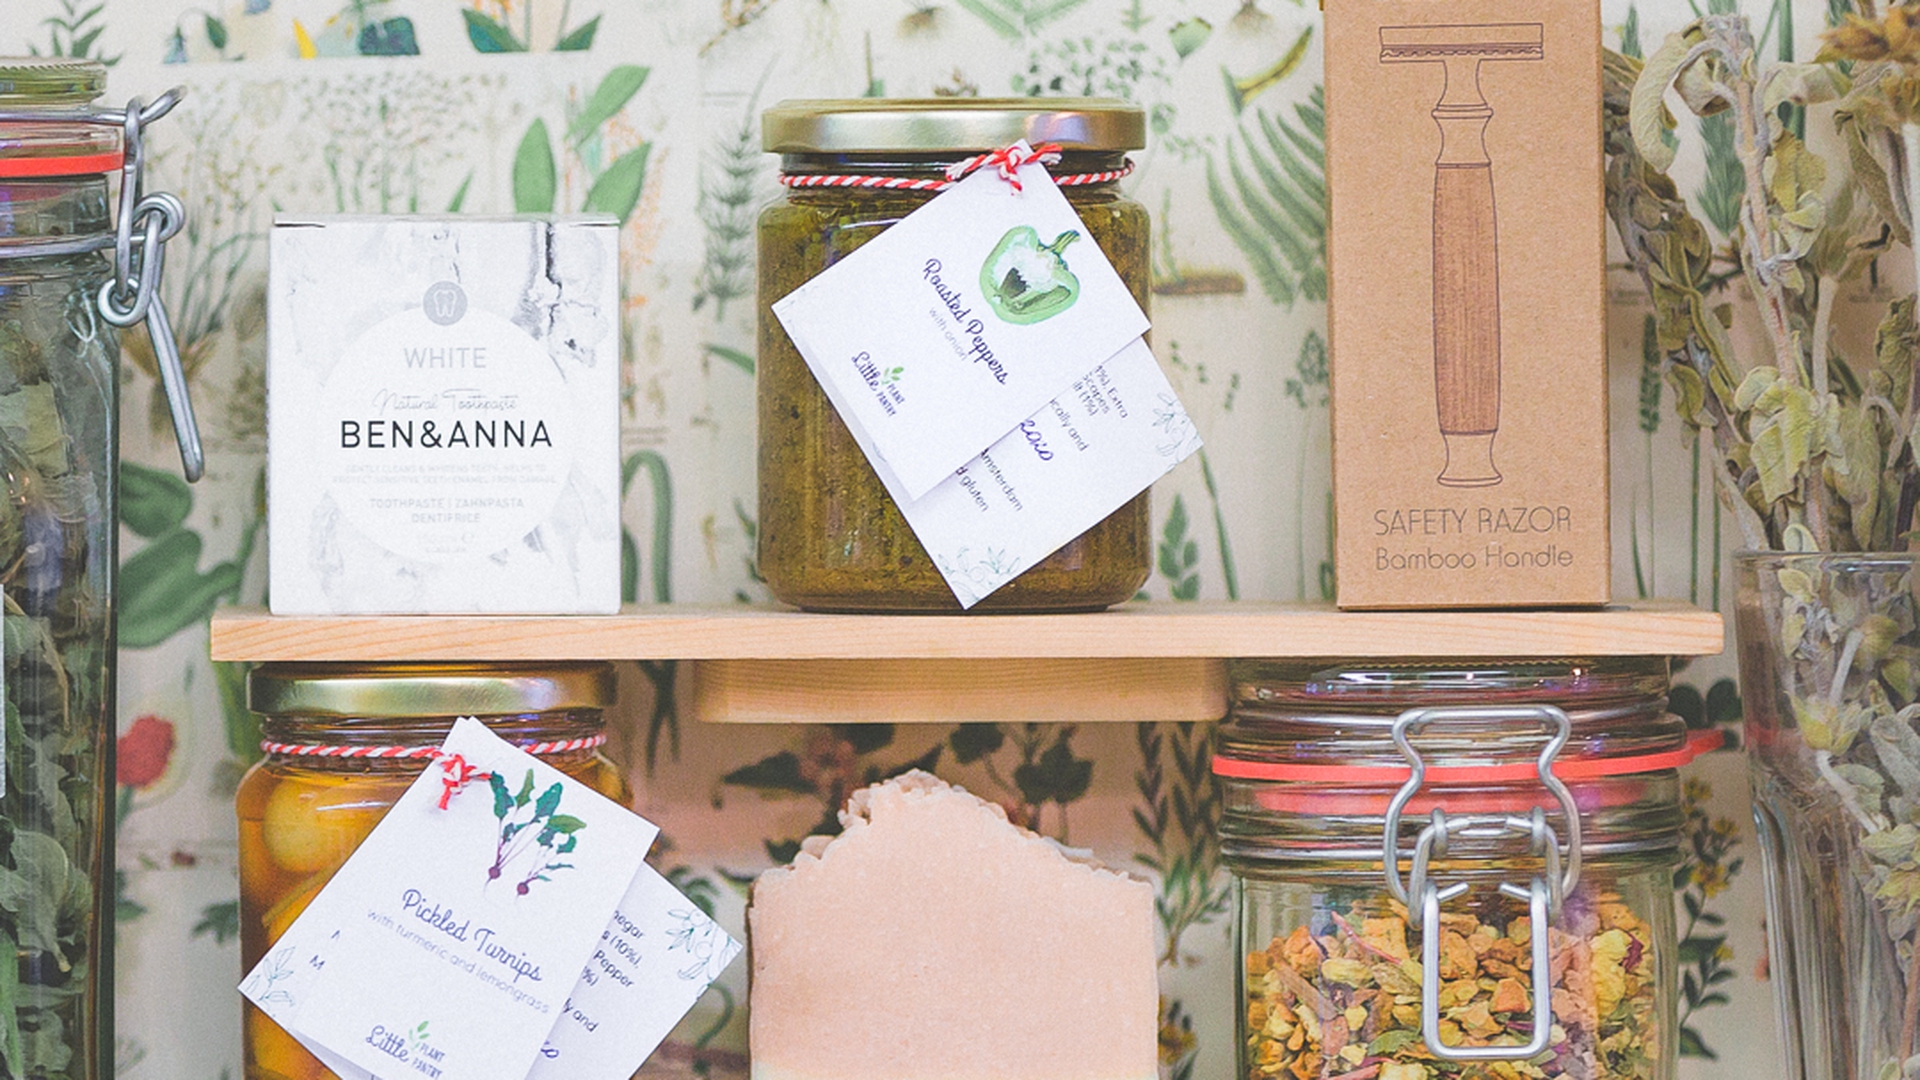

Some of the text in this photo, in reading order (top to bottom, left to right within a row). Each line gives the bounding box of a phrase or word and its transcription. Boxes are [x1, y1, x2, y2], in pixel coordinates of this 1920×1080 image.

[923, 258, 1008, 385] Roasted Peppers
[929, 307, 968, 361] with onion
[403, 347, 487, 369] WHITE
[851, 351, 905, 405] Little PLANT
[371, 387, 520, 416] Natural Toothpaste
[1107, 386, 1128, 419] Extra
[341, 420, 553, 448] BEN&ANNA
[1068, 427, 1090, 452] and
[370, 498, 445, 509] TOOTHPASTE
[455, 498, 525, 509] ZAHNPASTA
[959, 475, 990, 512] gluten
[411, 513, 481, 524] DENTIFRICE
[1373, 506, 1571, 536] SAFETY RAZOR
[1376, 545, 1574, 571] Bamboo Handle
[402, 888, 542, 983] Pickled Turnips
[367, 909, 550, 1014] with turmeric and lemongrass
[593, 949, 635, 988] Pepper
[572, 1009, 599, 1033] and
[365, 1025, 446, 1063] Little PLANT
